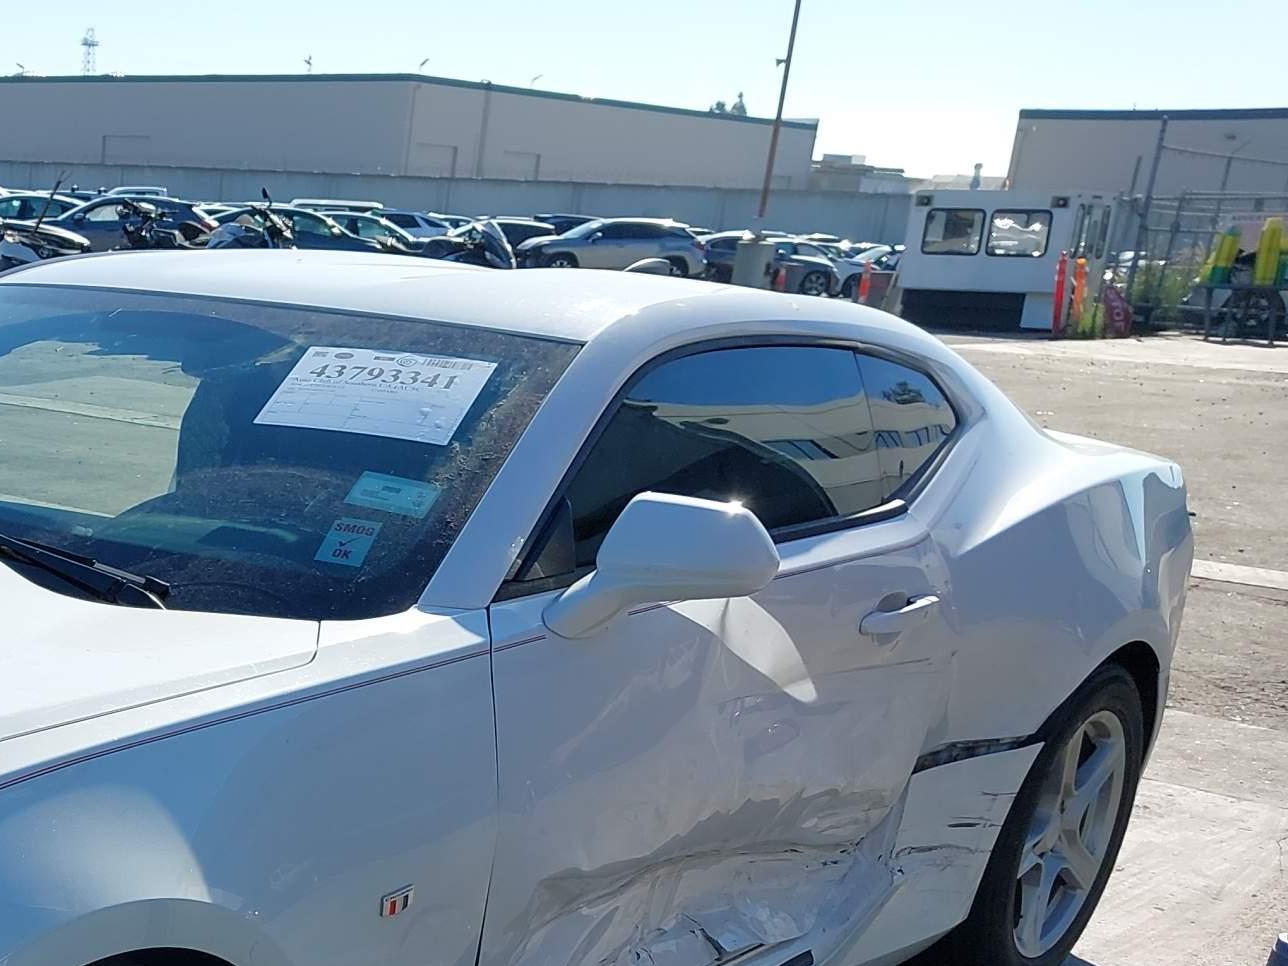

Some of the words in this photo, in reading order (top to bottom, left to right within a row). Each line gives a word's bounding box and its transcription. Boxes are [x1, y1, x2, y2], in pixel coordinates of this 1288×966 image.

[309, 364, 458, 390] 43793341
[334, 522, 376, 537] SMOG
[332, 549, 352, 560] OK
